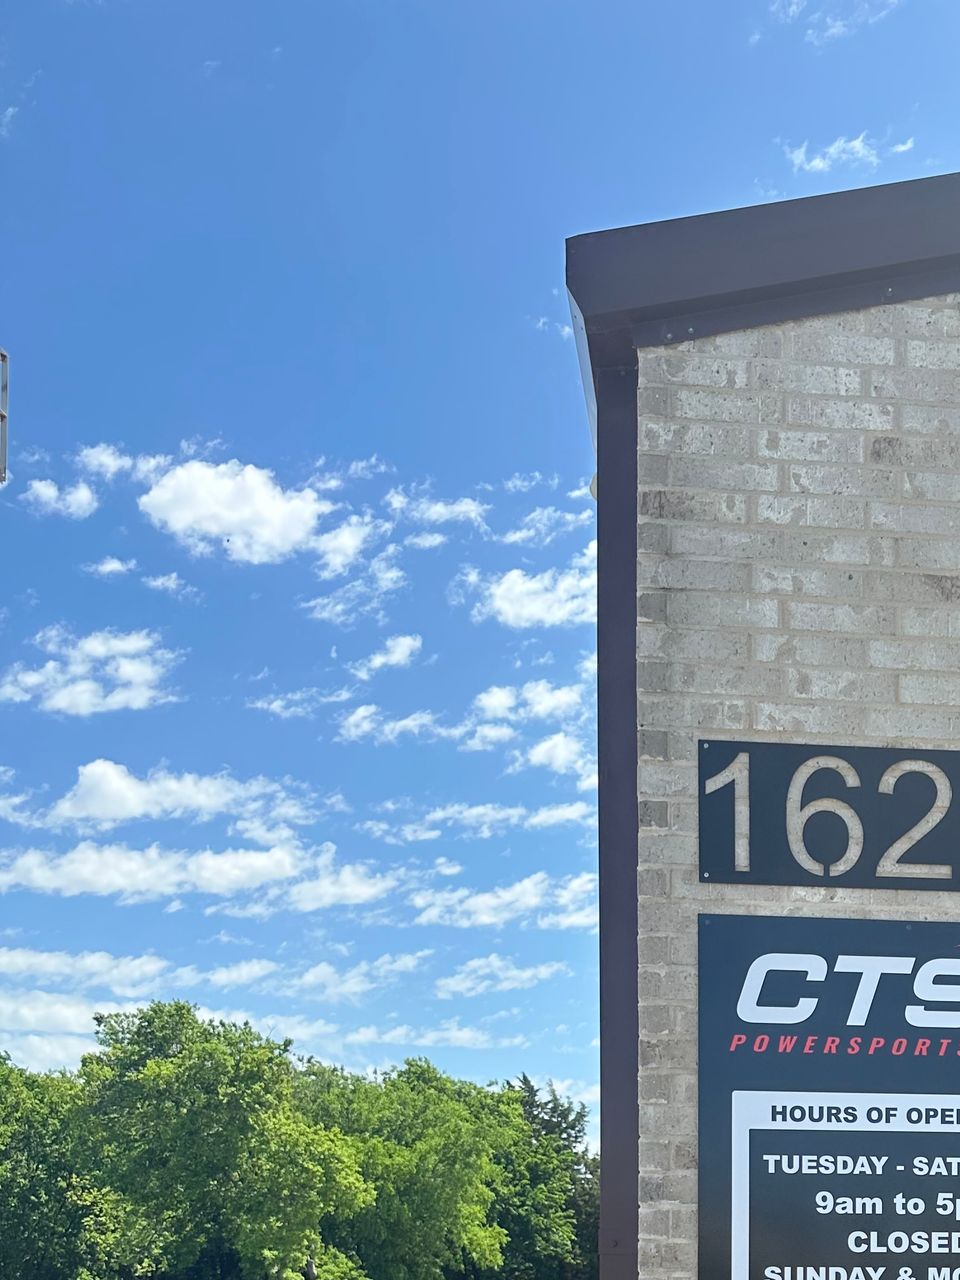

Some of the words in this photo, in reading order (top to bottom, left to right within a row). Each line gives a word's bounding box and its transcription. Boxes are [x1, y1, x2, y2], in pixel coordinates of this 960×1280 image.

[771, 1105, 858, 1124] HOURS
[866, 1107, 898, 1124] OF
[763, 1154, 889, 1175] TUESDAY
[815, 1191, 883, 1215] 9am
[893, 1193, 926, 1216] to
